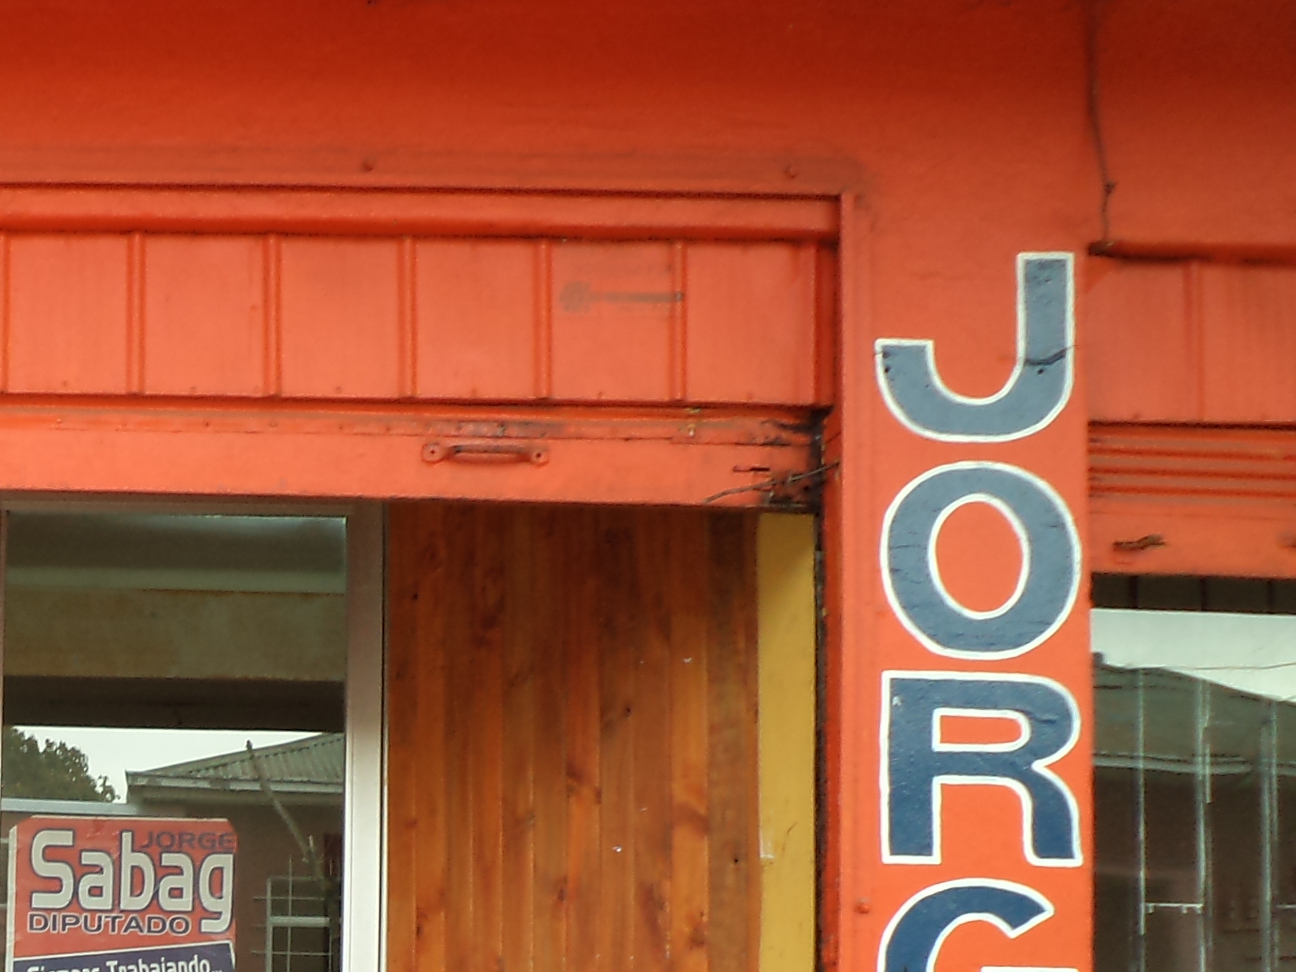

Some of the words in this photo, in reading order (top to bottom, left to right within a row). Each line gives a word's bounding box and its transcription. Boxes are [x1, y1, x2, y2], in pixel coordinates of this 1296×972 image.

[141, 830, 236, 851] JORGE
[30, 829, 235, 934] Sabag
[27, 912, 191, 935] DIPUTADO
